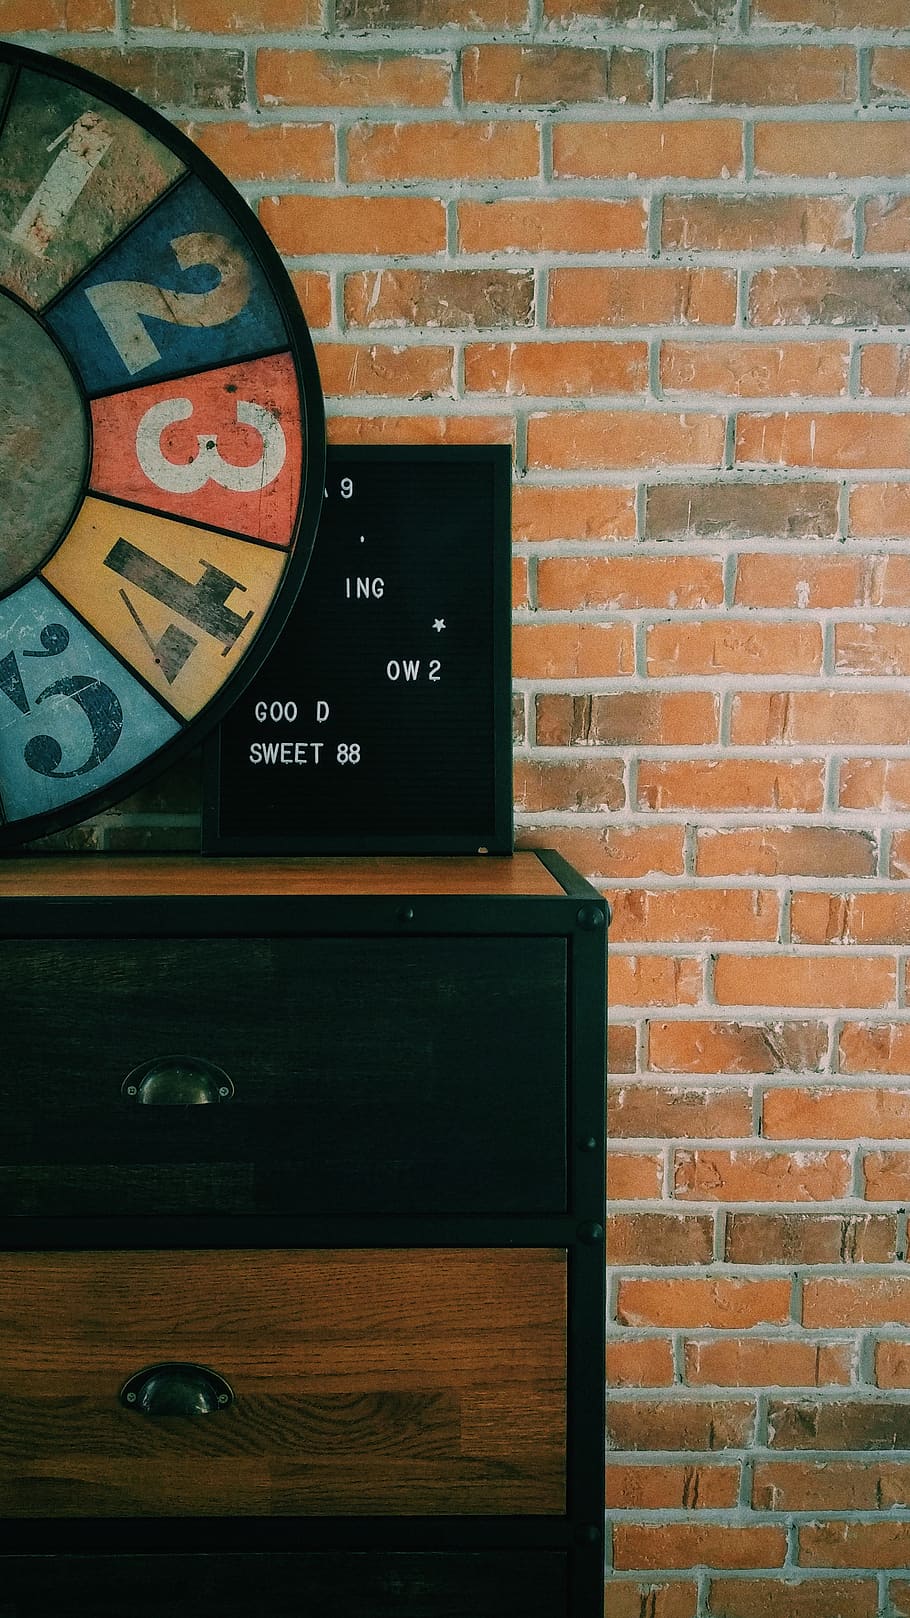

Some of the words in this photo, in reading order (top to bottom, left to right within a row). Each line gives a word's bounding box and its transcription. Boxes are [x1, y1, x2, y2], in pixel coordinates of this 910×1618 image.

[10, 109, 114, 259] 1
[84, 231, 251, 376] 2
[135, 397, 287, 495] 3
[340, 477, 353, 499] 9
[103, 537, 255, 686] 4
[345, 576, 385, 599] ING
[0, 623, 124, 779] 5
[386, 659, 421, 682] OW
[428, 659, 441, 682] 2
[249, 742, 325, 765] SWEET
[336, 742, 361, 765] 88
